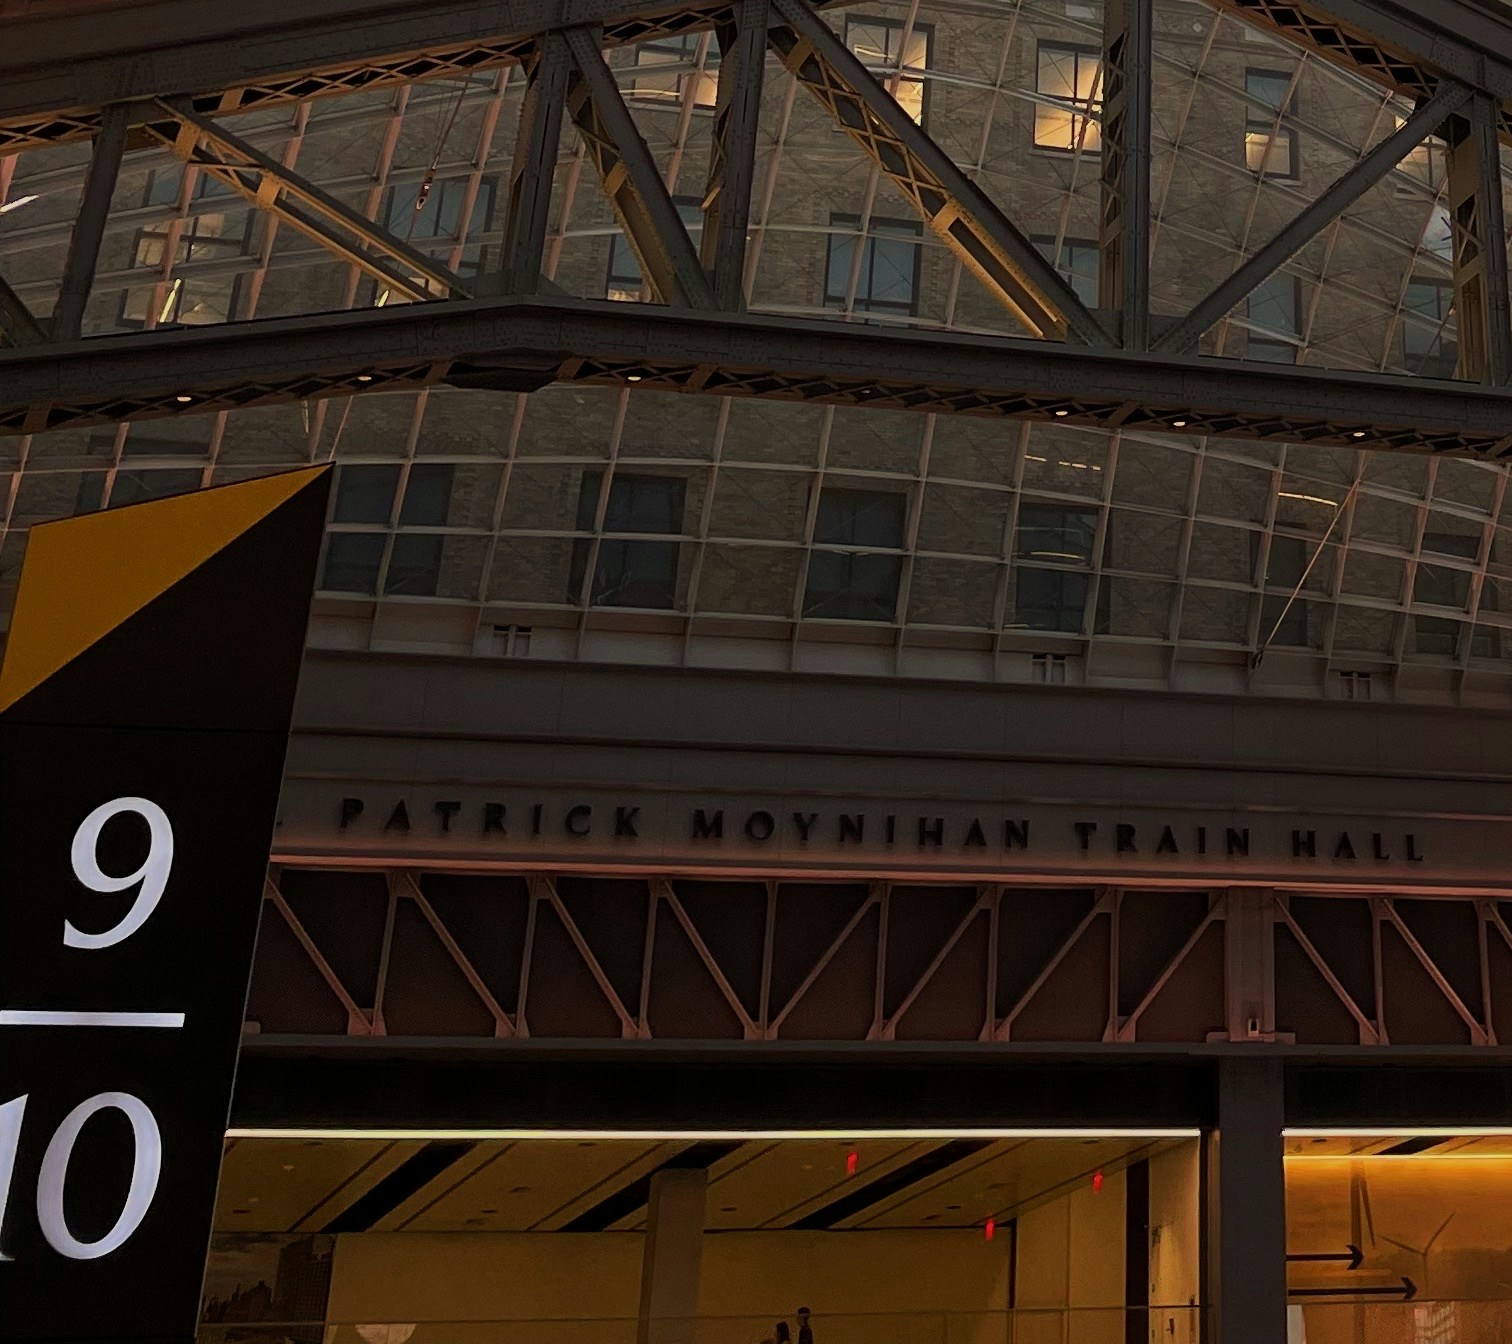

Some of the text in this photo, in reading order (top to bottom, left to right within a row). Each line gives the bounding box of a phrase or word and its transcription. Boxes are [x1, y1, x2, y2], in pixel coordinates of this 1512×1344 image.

[62, 796, 176, 951] 9
[339, 798, 1424, 862] PATRICK MOYNIHAN TRAIN HALL
